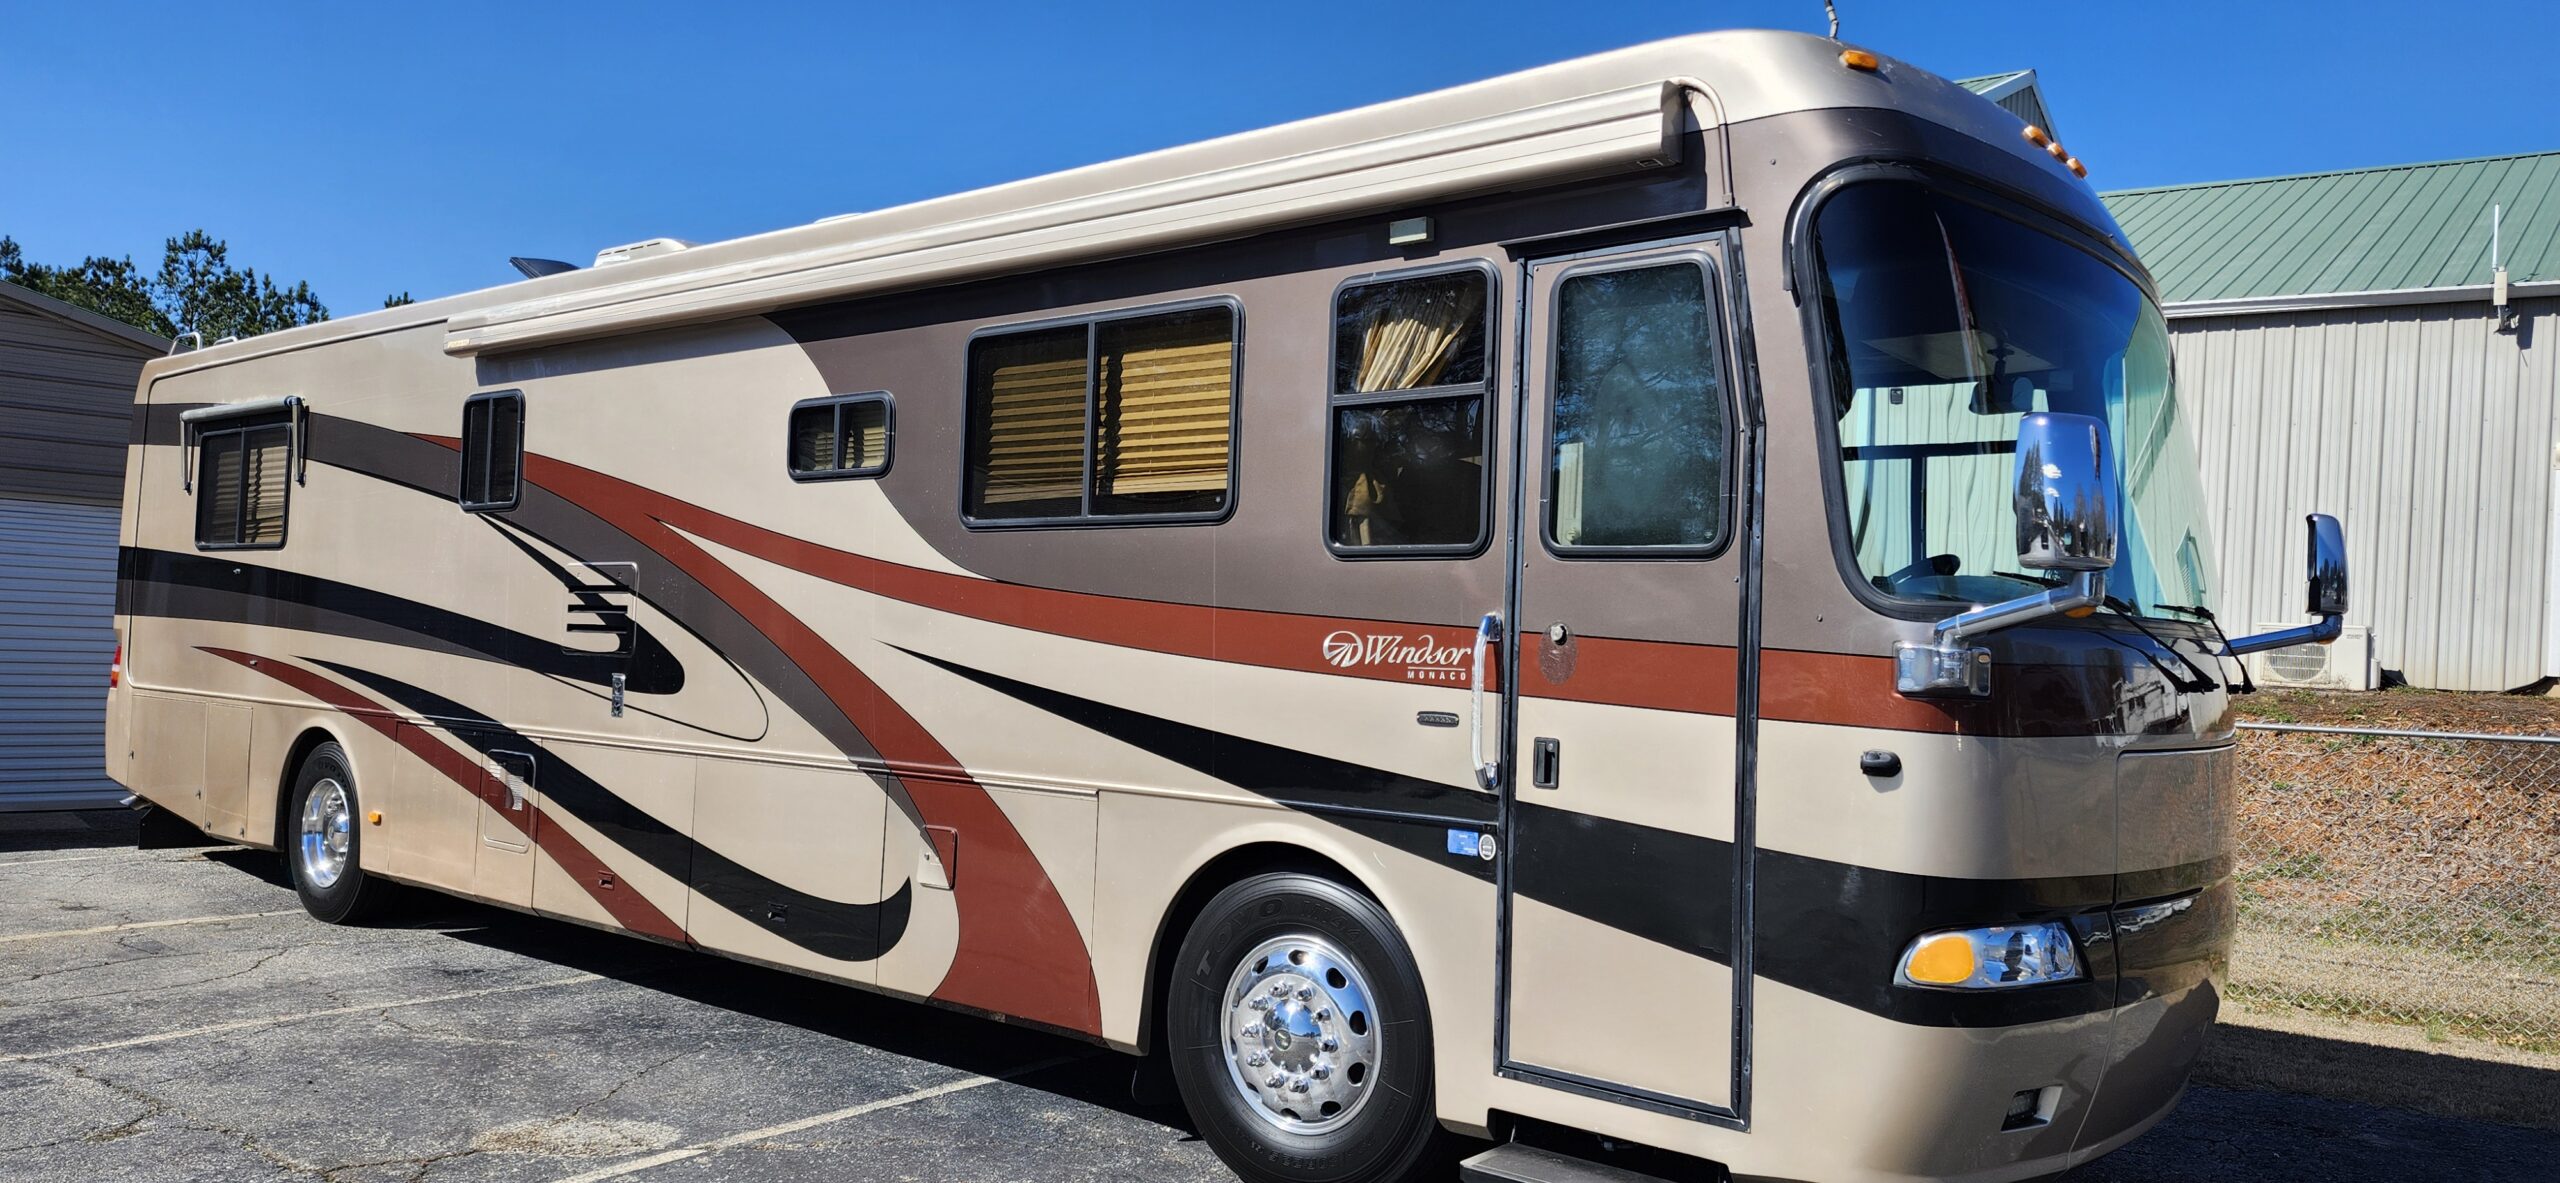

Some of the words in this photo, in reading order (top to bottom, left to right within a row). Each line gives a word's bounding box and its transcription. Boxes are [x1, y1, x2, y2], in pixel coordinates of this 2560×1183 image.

[1364, 634, 1471, 666] Windsor
[1407, 671, 1467, 681] MONACO
[1196, 899, 1283, 977] TOYO
